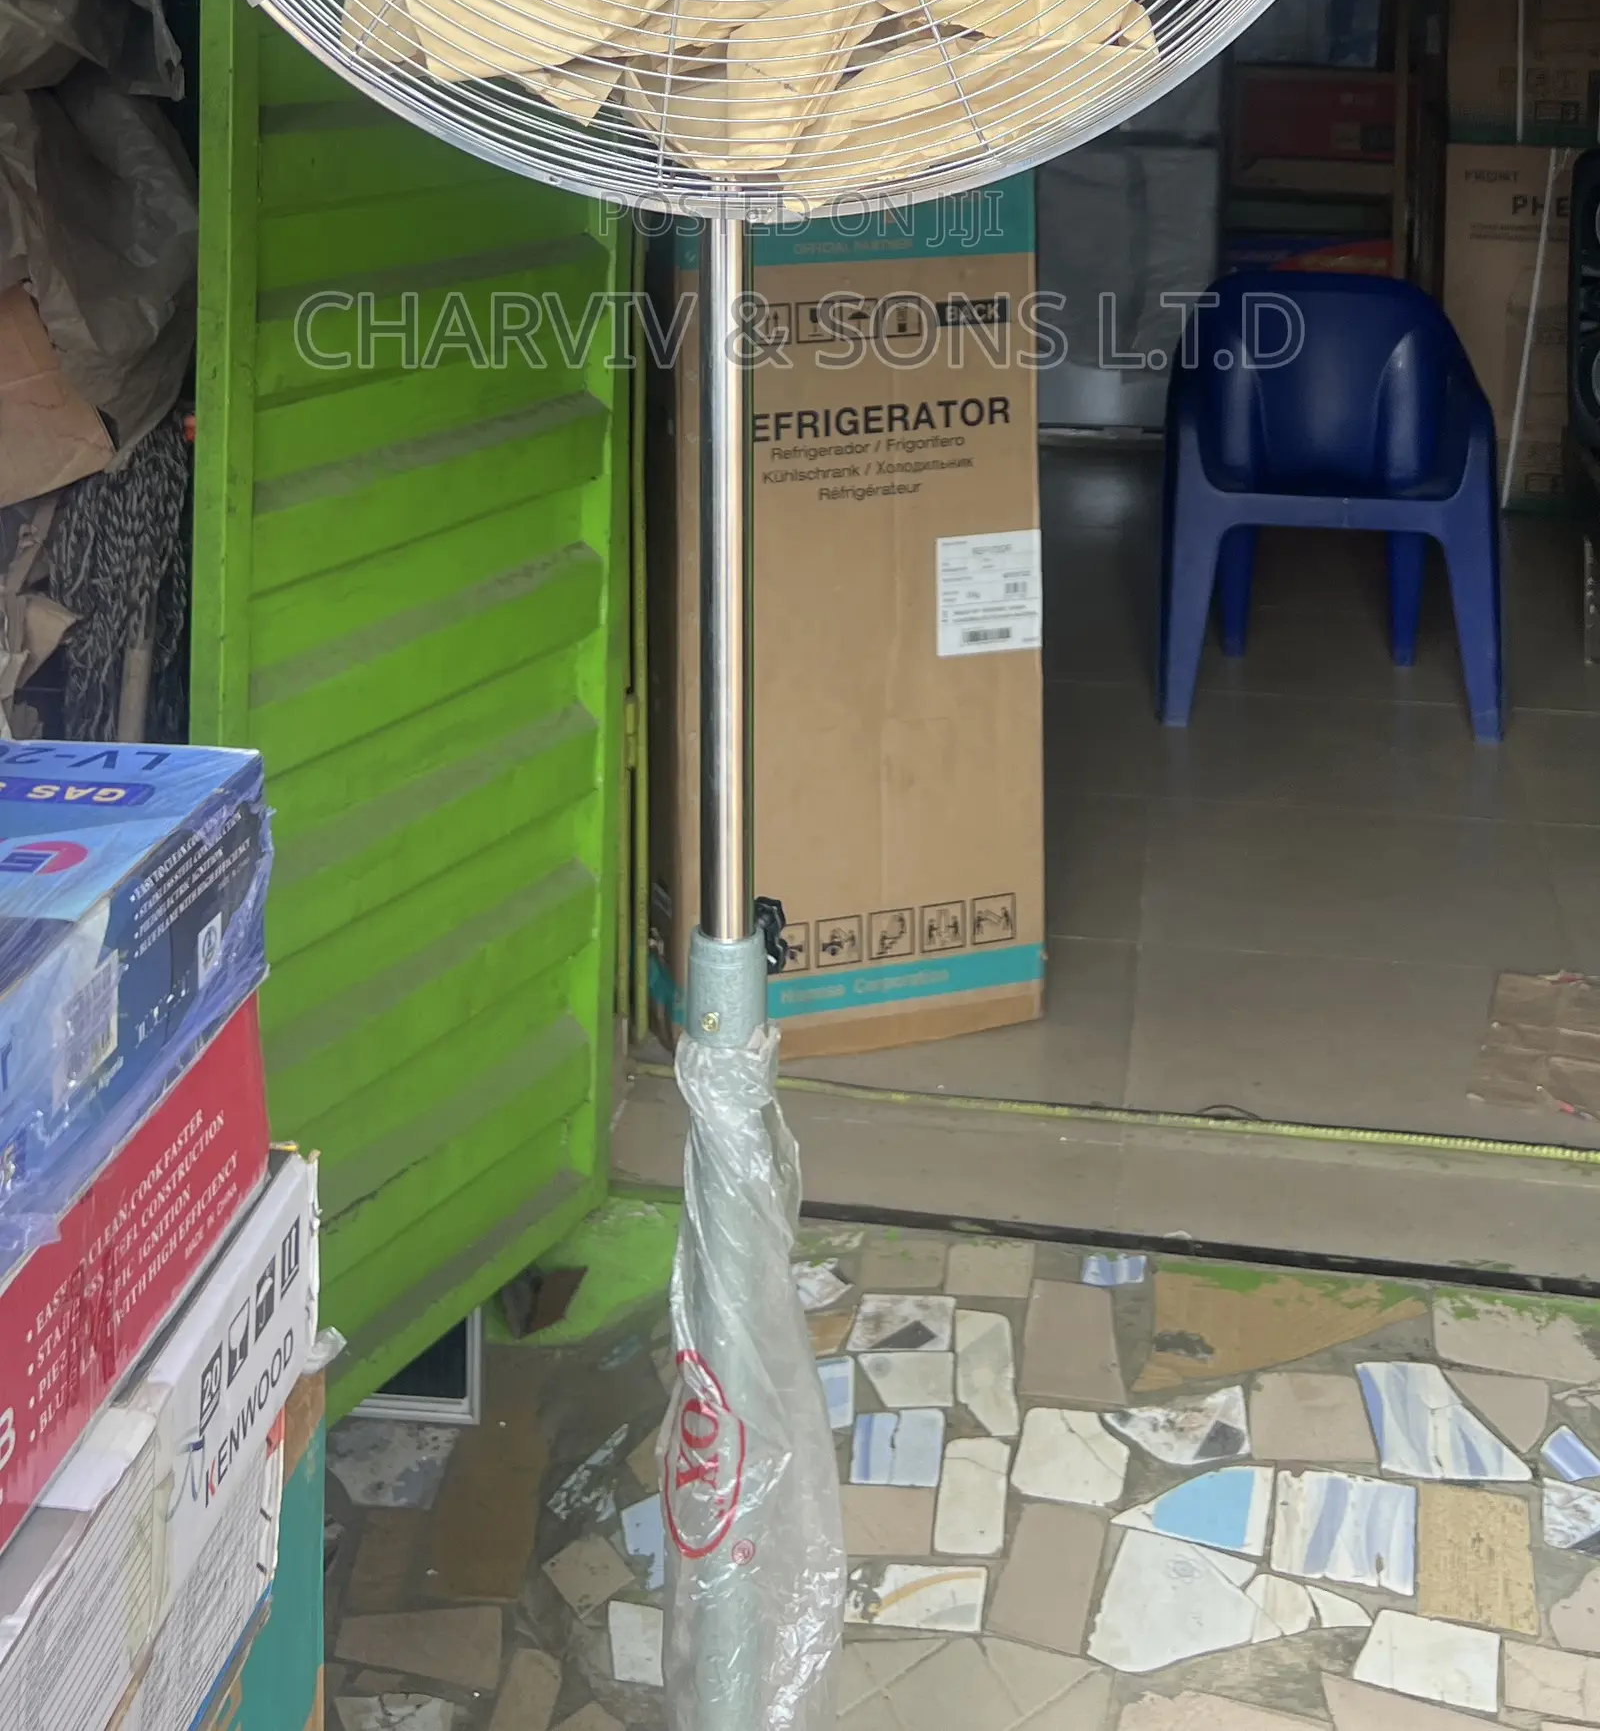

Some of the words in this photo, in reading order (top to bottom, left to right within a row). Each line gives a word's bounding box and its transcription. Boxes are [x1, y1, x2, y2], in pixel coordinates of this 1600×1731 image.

[944, 302, 1000, 322] BACK
[753, 395, 1011, 443] EFRIGERATOR
[770, 441, 871, 462] Refrigerador
[26, 784, 127, 803] GAS
[165, 1106, 202, 1170] FASTER
[141, 1106, 224, 1233] CONSTRUCTION
[138, 1181, 191, 1268] IGNITION
[148, 1230, 177, 1286] HIGH
[179, 1147, 237, 1245] EFFICIENCY
[203, 1355, 222, 1410] 20
[205, 1328, 294, 1508] KENWOOD
